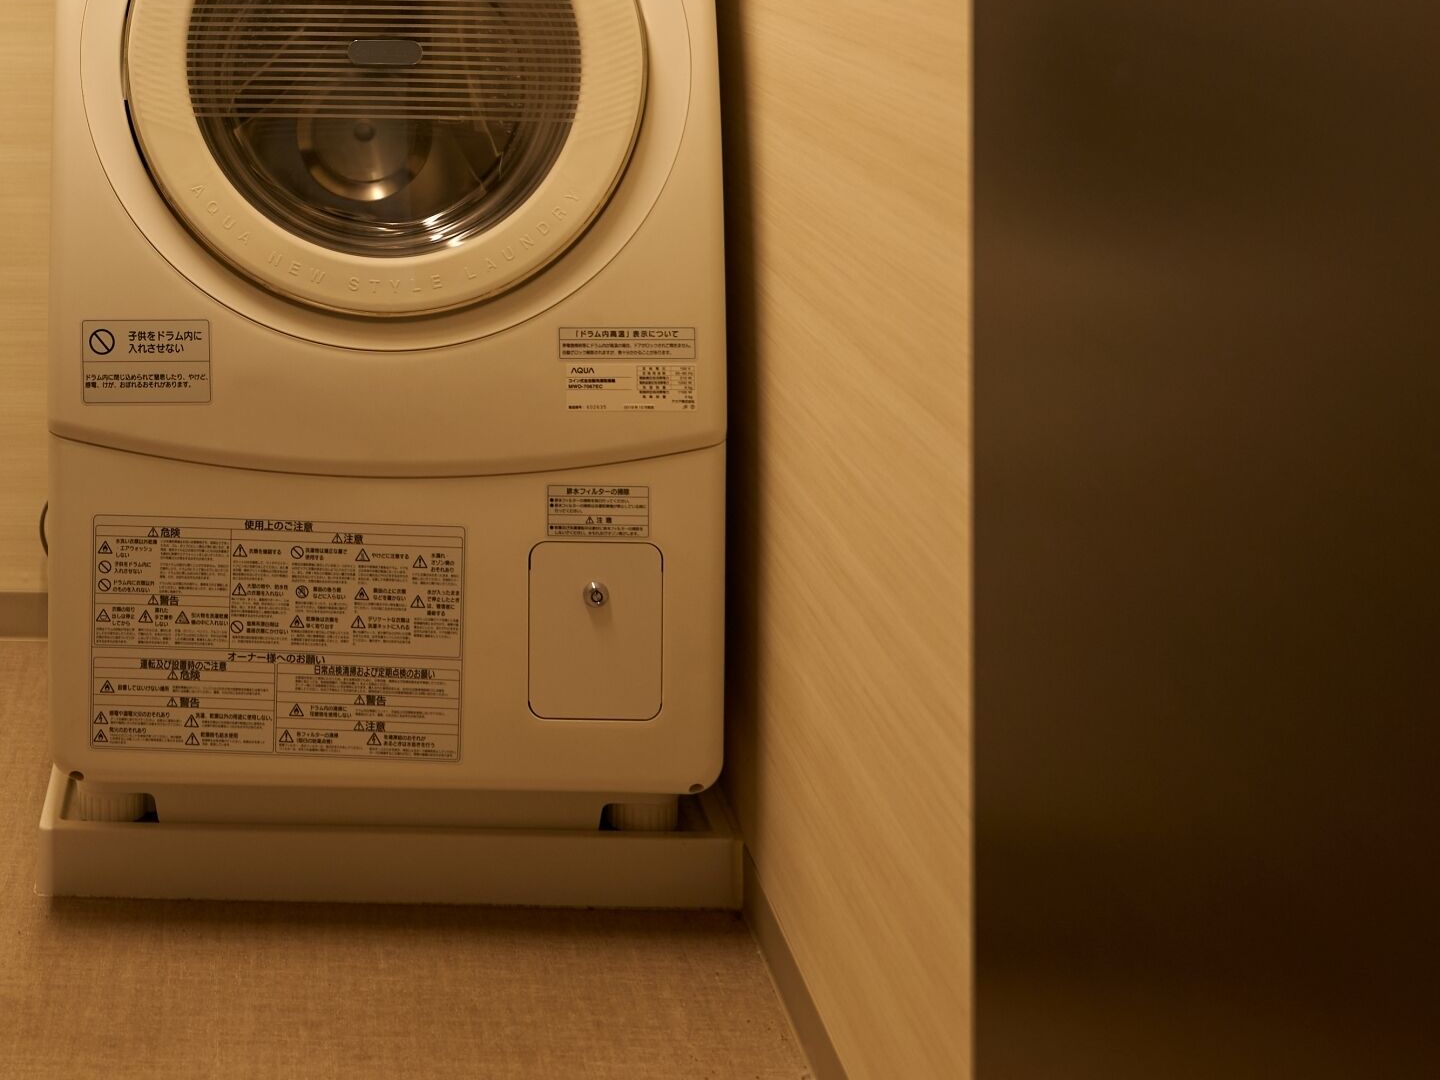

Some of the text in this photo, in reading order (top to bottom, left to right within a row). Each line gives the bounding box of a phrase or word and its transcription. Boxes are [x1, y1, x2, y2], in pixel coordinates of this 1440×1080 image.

[128, 331, 202, 341] 子供をドラム内に
[128, 344, 184, 353] 入れさせない
[244, 520, 312, 532] 使用上のご注意
